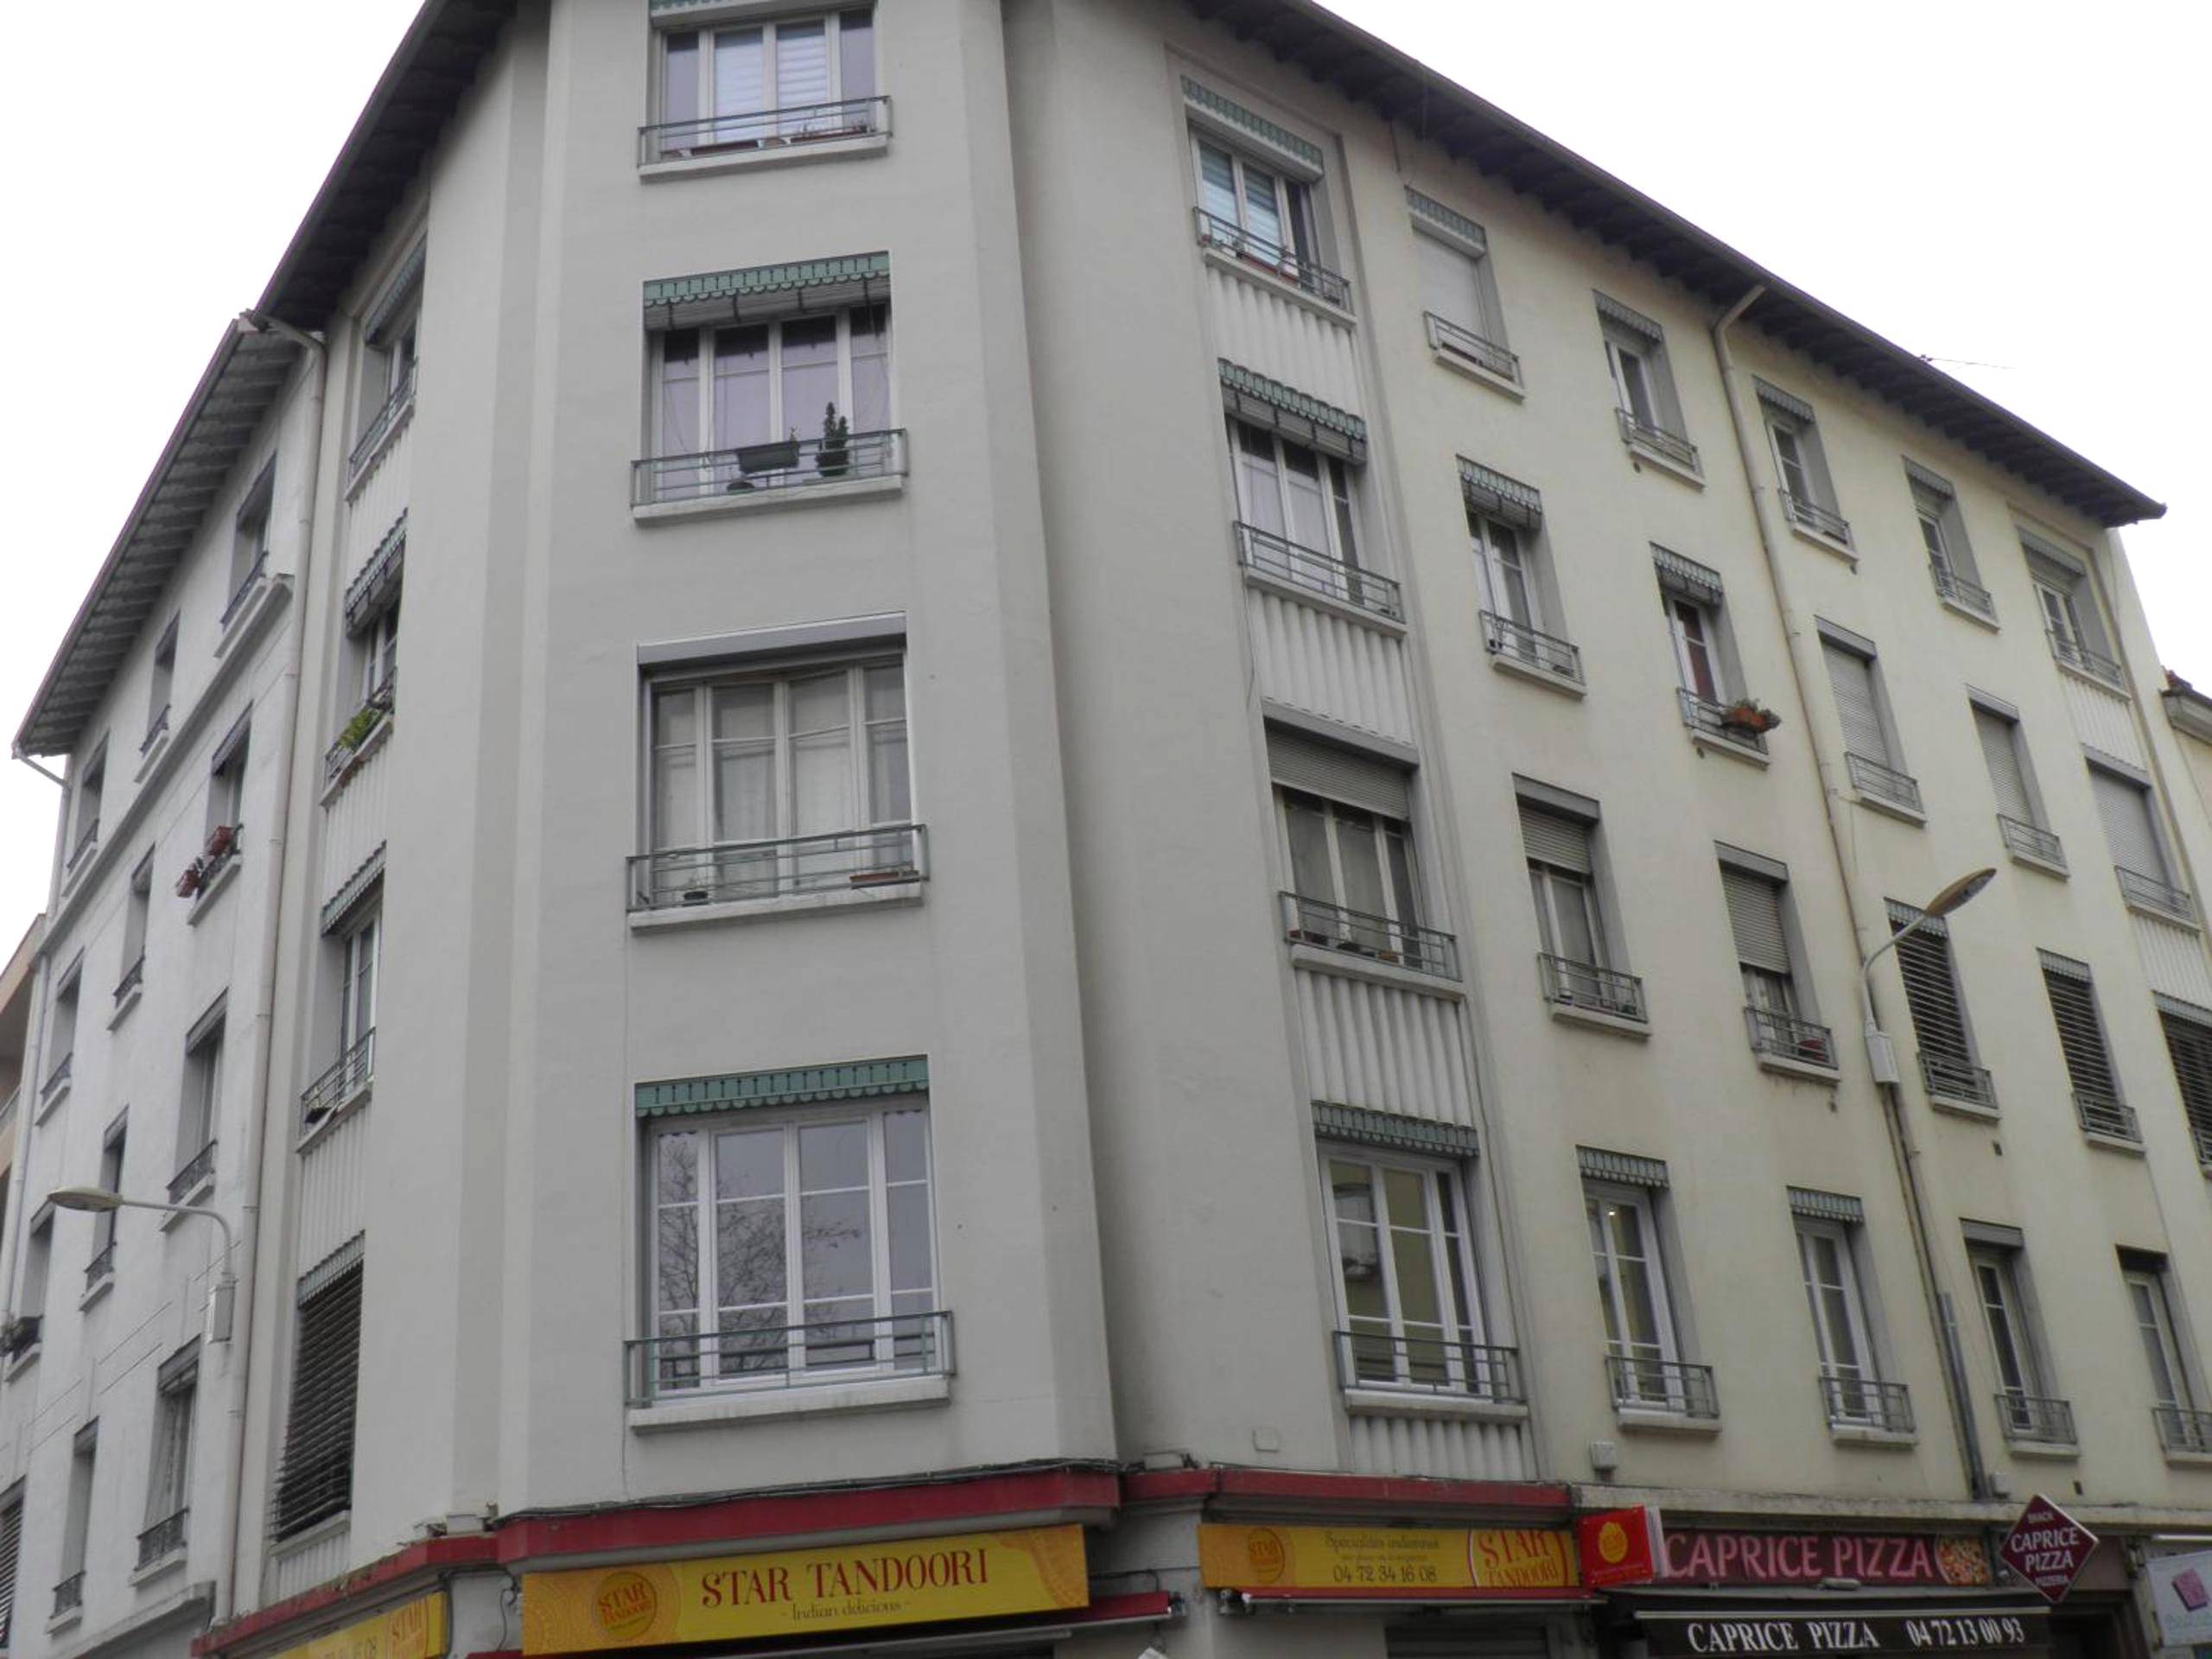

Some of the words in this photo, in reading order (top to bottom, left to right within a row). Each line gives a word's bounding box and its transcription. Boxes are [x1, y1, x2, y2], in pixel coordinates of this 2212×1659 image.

[1478, 1529, 1550, 1567] STAR
[2011, 1527, 2079, 1553] CAPRICE
[1665, 1535, 1821, 1579] CAPRICE
[1833, 1536, 1934, 1579] PIZZA
[2025, 1549, 2074, 1572] PIZZA
[702, 1567, 791, 1607] STAR
[807, 1548, 989, 1599] TANDOORI
[1332, 1566, 1352, 1583] 04
[1357, 1565, 1374, 1582] 72
[1378, 1565, 1395, 1582] 34
[1401, 1564, 1415, 1582] 16
[1419, 1565, 1437, 1582] 08
[598, 1580, 646, 1608] STAR
[791, 1604, 838, 1620] Indian
[842, 1599, 901, 1616] delicious
[1688, 1622, 1800, 1654] CAPRICE
[1807, 1620, 1880, 1649] PIZZA
[1905, 1619, 1932, 1647] 04
[1930, 1618, 1956, 1646] 72
[1955, 1618, 1979, 1645] 13
[1978, 1616, 2003, 1645] 00
[2001, 1616, 2024, 1643] 93
